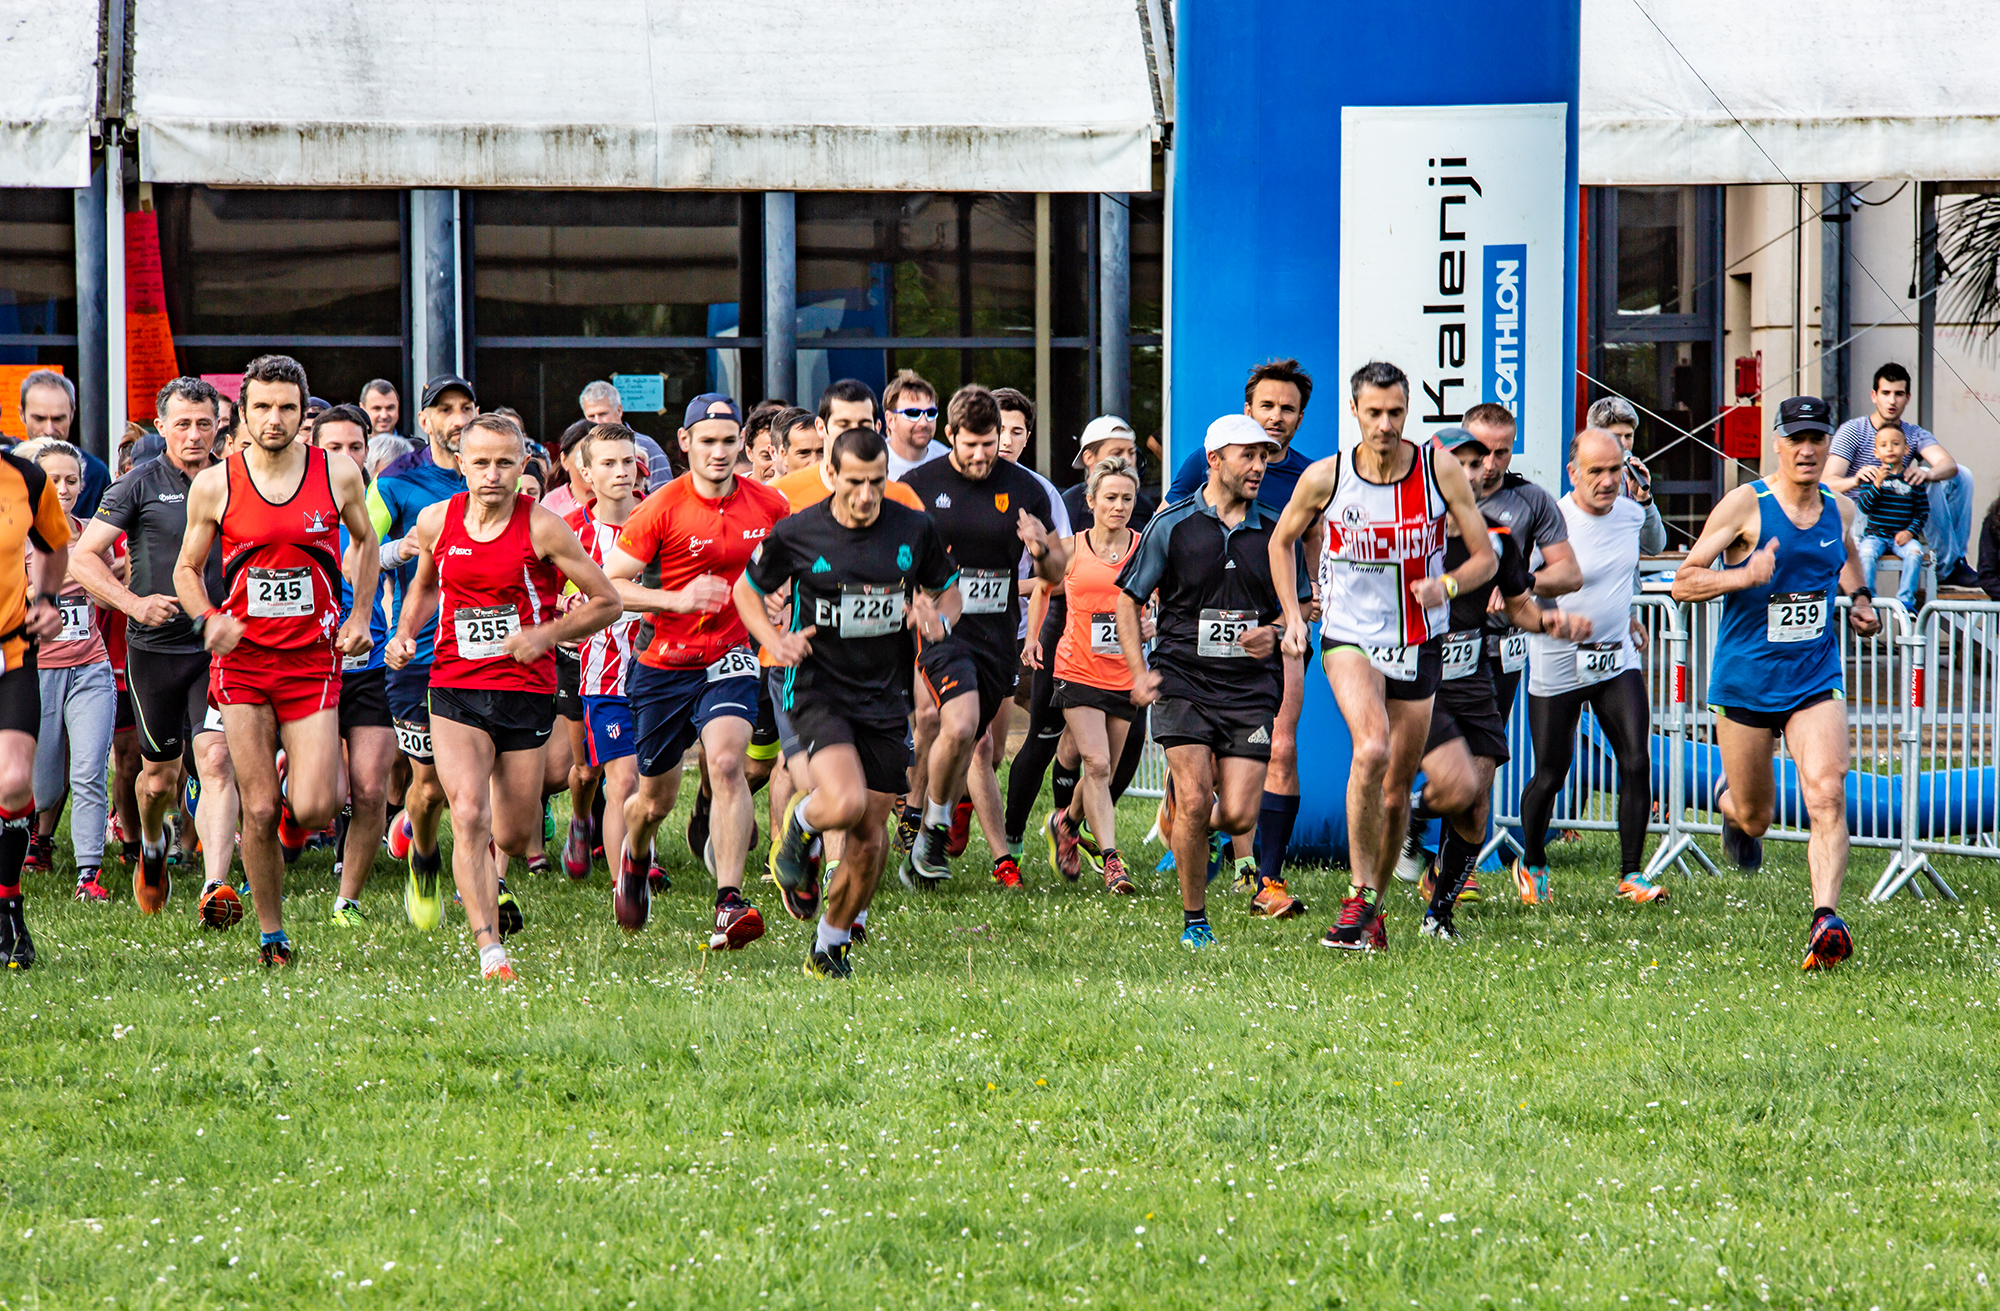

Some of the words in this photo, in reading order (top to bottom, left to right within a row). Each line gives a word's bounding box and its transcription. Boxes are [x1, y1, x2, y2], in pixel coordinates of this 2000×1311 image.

[1422, 157, 1482, 423] Kalenji
[1495, 259, 1519, 440] ECATHLON
[259, 581, 302, 601] 245
[969, 582, 1002, 598] 247
[853, 600, 893, 620] 226
[1781, 604, 1819, 625] 259
[467, 619, 510, 642] 255
[1443, 643, 1472, 664] 279
[720, 654, 755, 675] 286
[401, 731, 432, 752] 206
